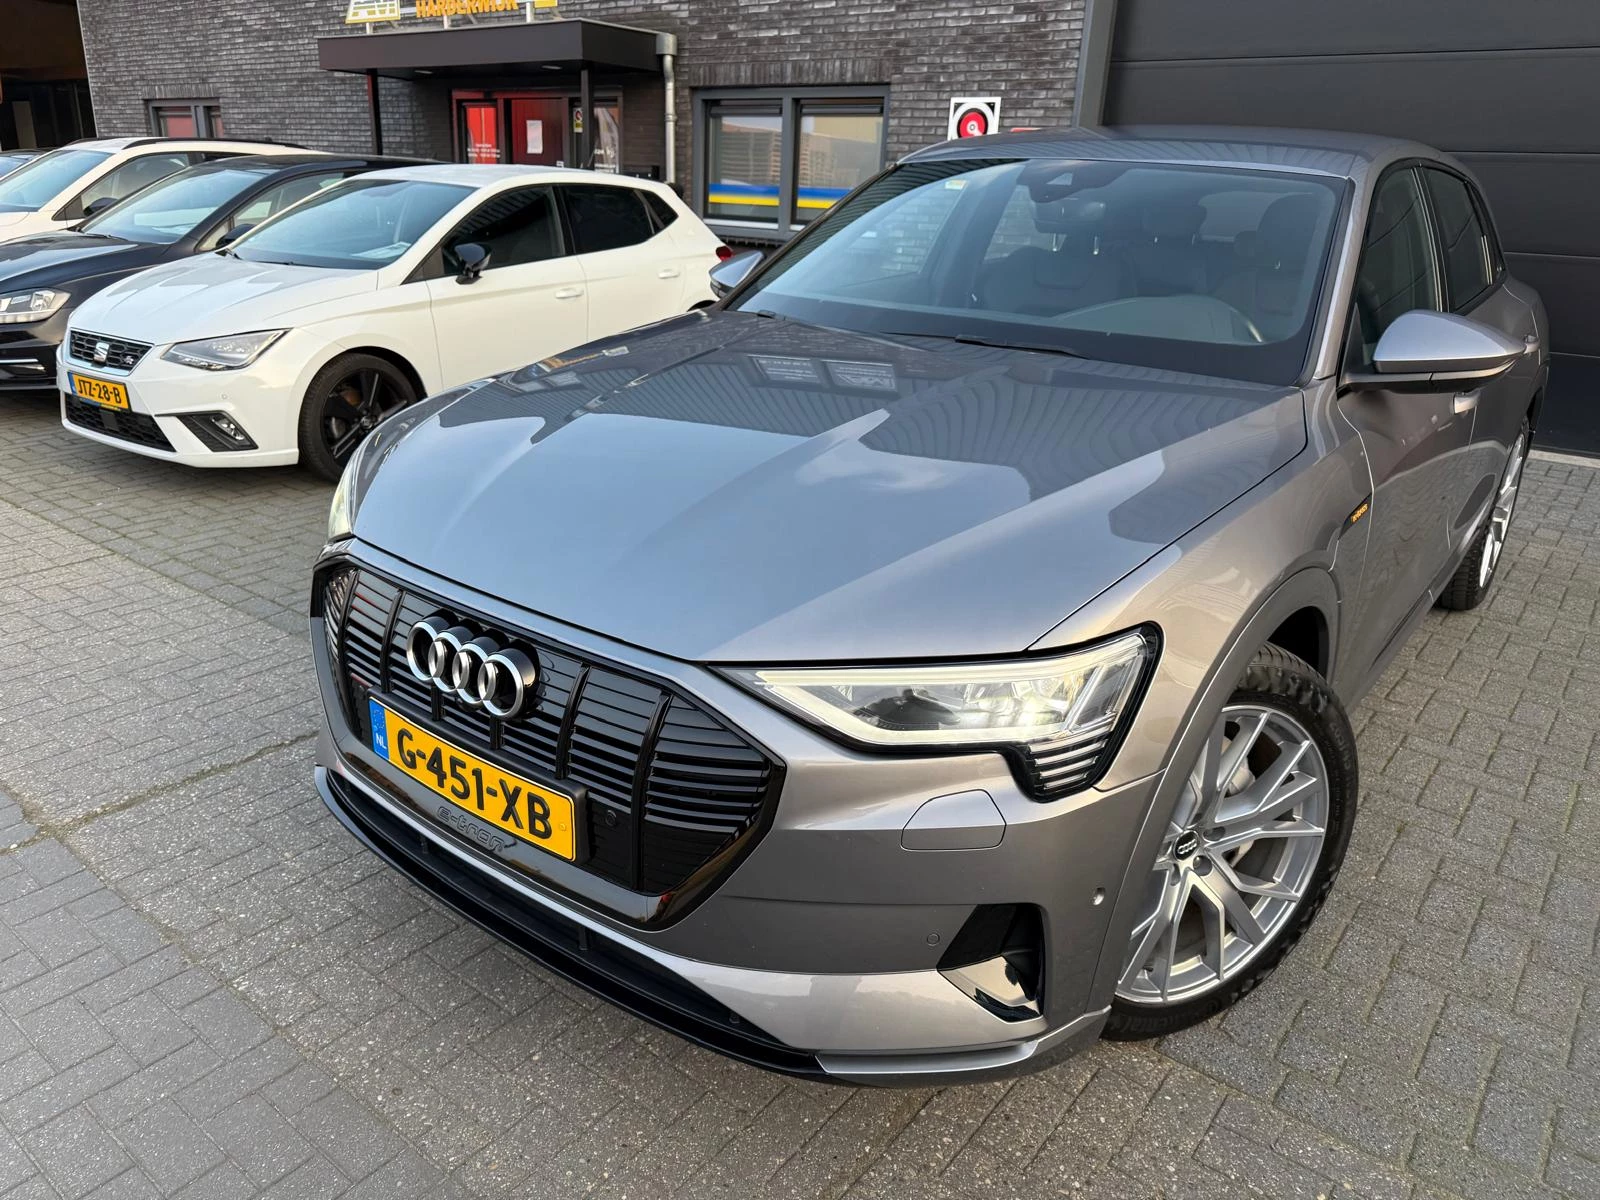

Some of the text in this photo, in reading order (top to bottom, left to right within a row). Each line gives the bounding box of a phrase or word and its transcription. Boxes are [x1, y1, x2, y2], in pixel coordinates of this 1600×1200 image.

[78, 379, 122, 404] JTZ-28-B
[375, 728, 553, 840] NL G-451-XB
[436, 805, 508, 852] e-tron
